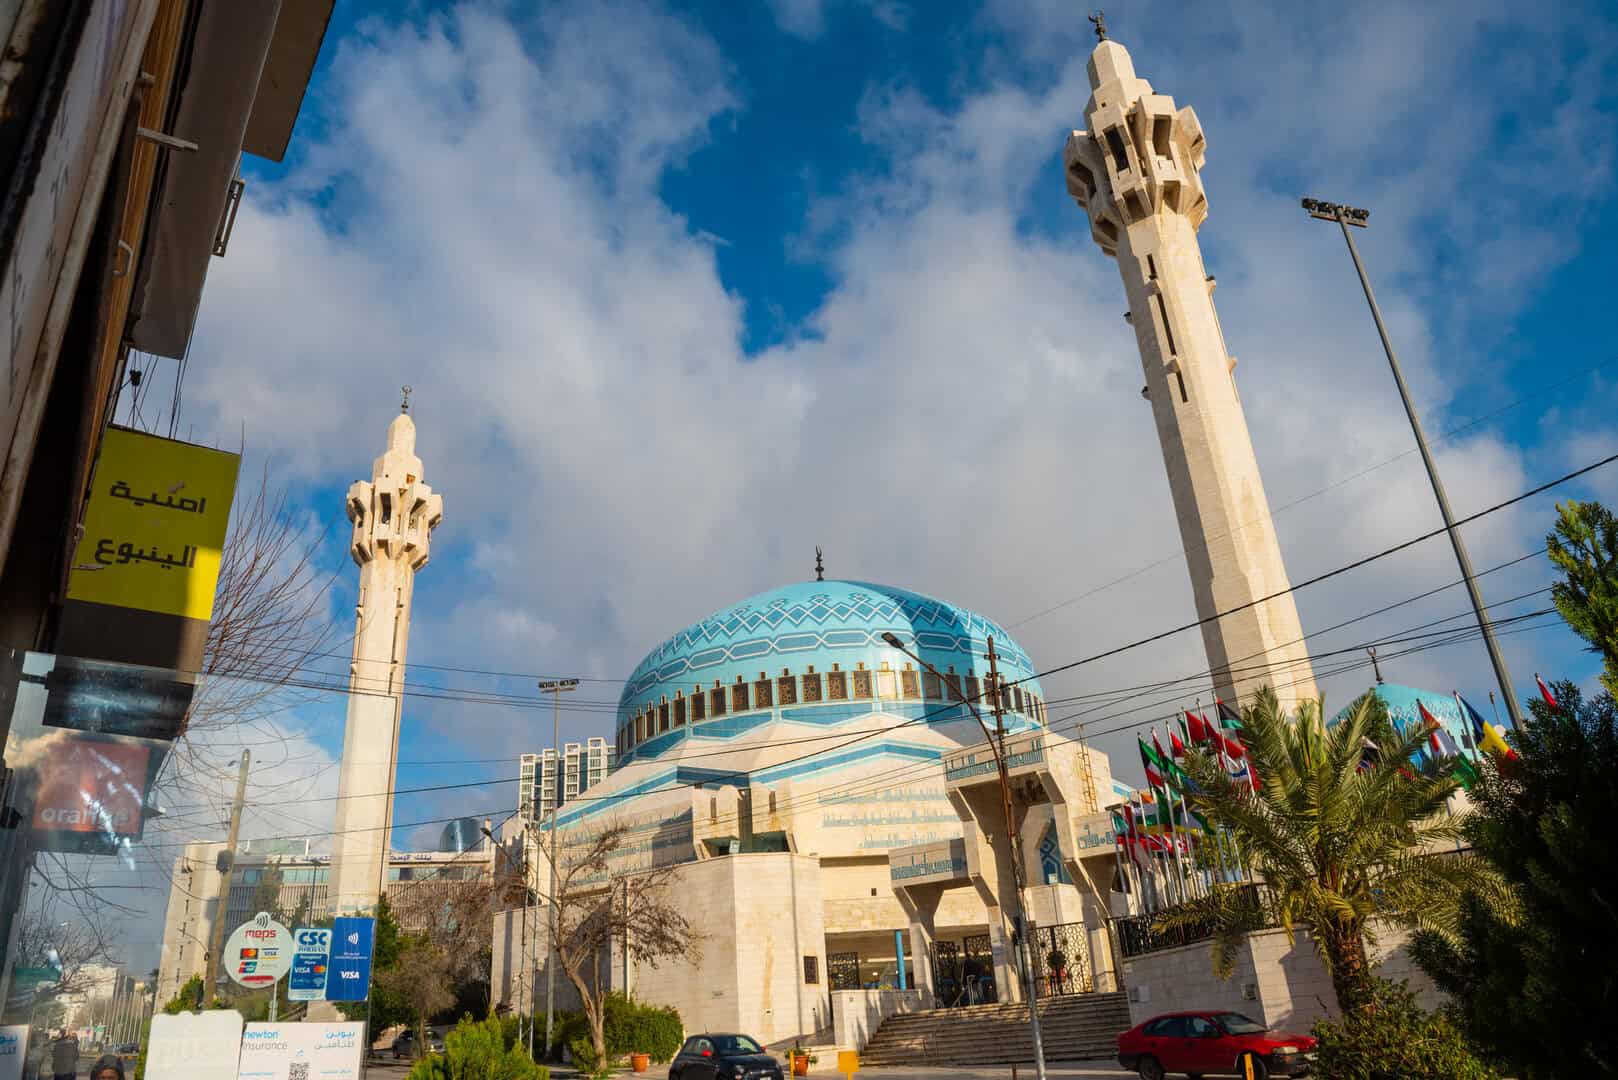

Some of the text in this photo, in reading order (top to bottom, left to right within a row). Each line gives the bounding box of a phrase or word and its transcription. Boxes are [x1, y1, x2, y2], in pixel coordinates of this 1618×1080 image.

[94, 539, 198, 569] الينبوع
[245, 930, 277, 941] meps
[298, 931, 327, 945] CSC
[341, 970, 360, 978] VISA
[244, 1031, 279, 1039] newton
